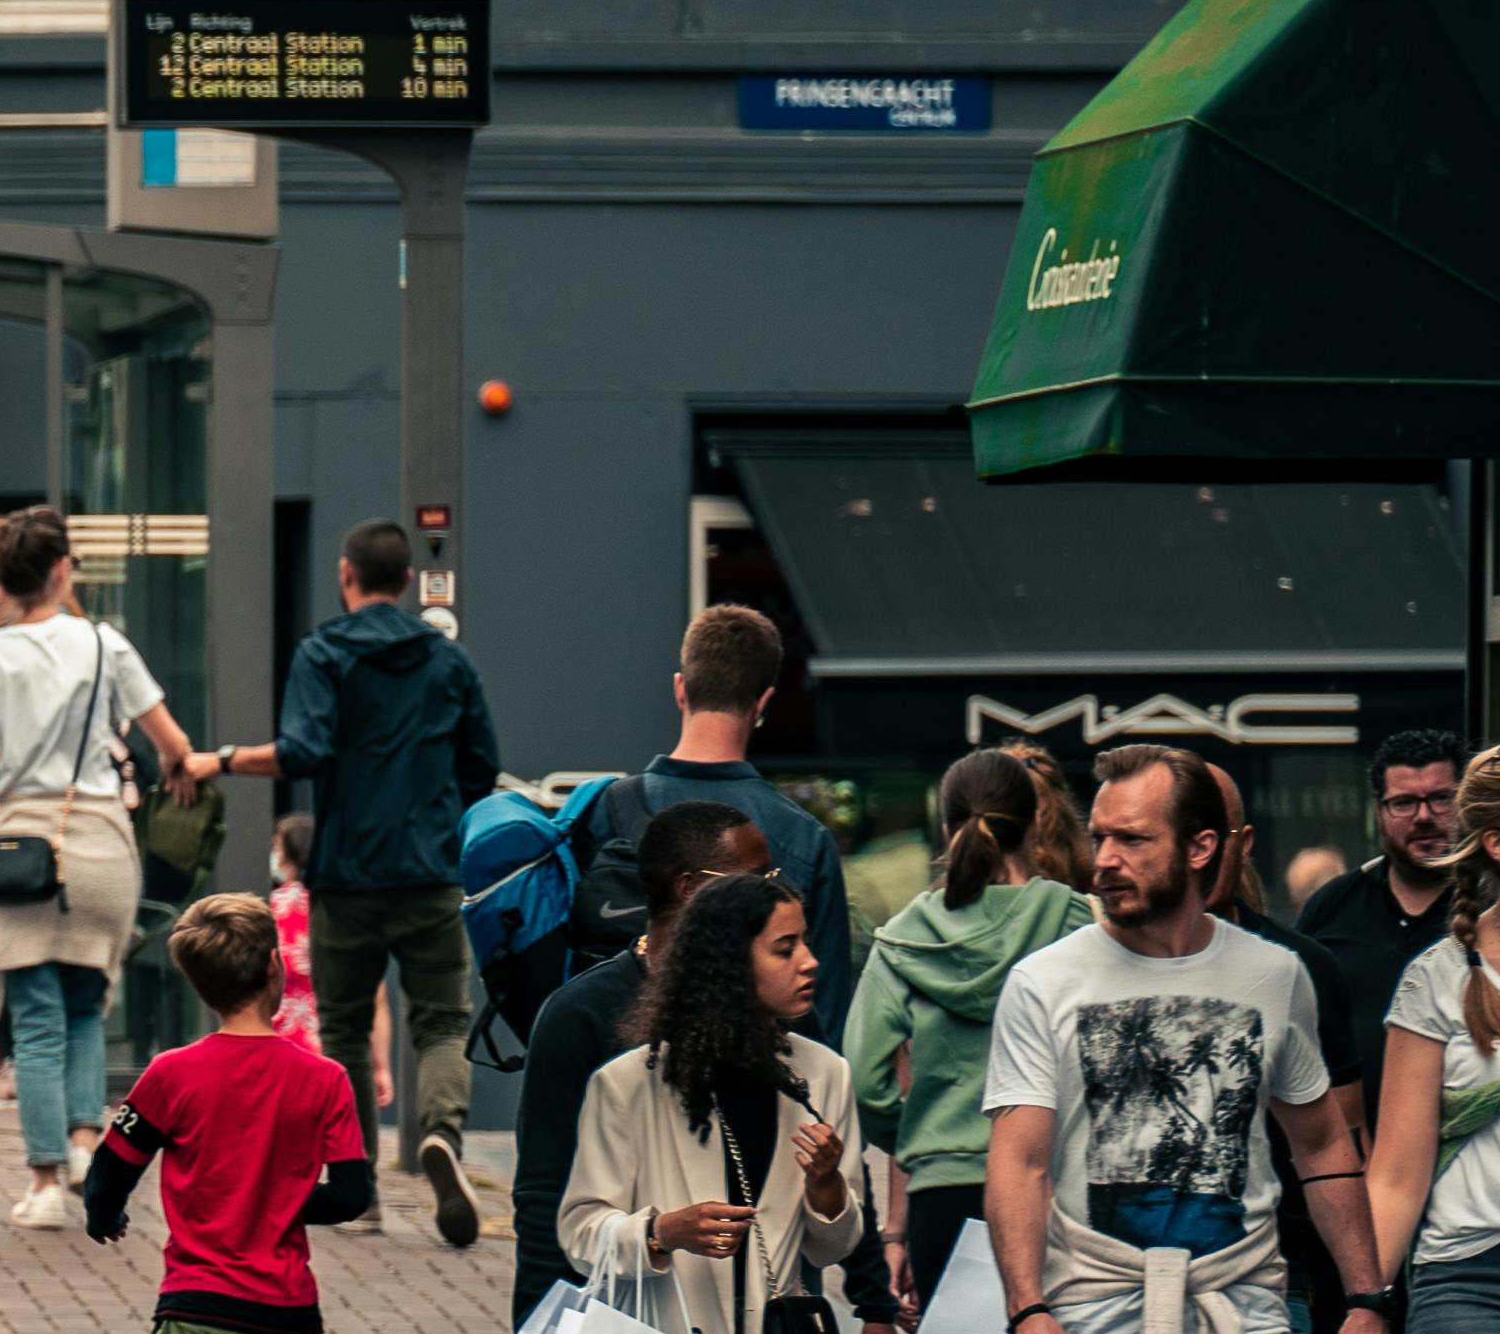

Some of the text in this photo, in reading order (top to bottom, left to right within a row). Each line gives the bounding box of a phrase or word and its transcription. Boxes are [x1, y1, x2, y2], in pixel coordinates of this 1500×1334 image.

[146, 13, 467, 34] Lijn Richting Vertrek
[171, 32, 468, 54] 2 Centraal Station 1 min
[159, 54, 185, 76] 12
[189, 54, 279, 76] Centraal
[285, 54, 364, 76] Station
[432, 56, 468, 76] min
[171, 76, 468, 98] 2 Centraal Station 10 min
[775, 79, 955, 108] PRINSENGRACHT
